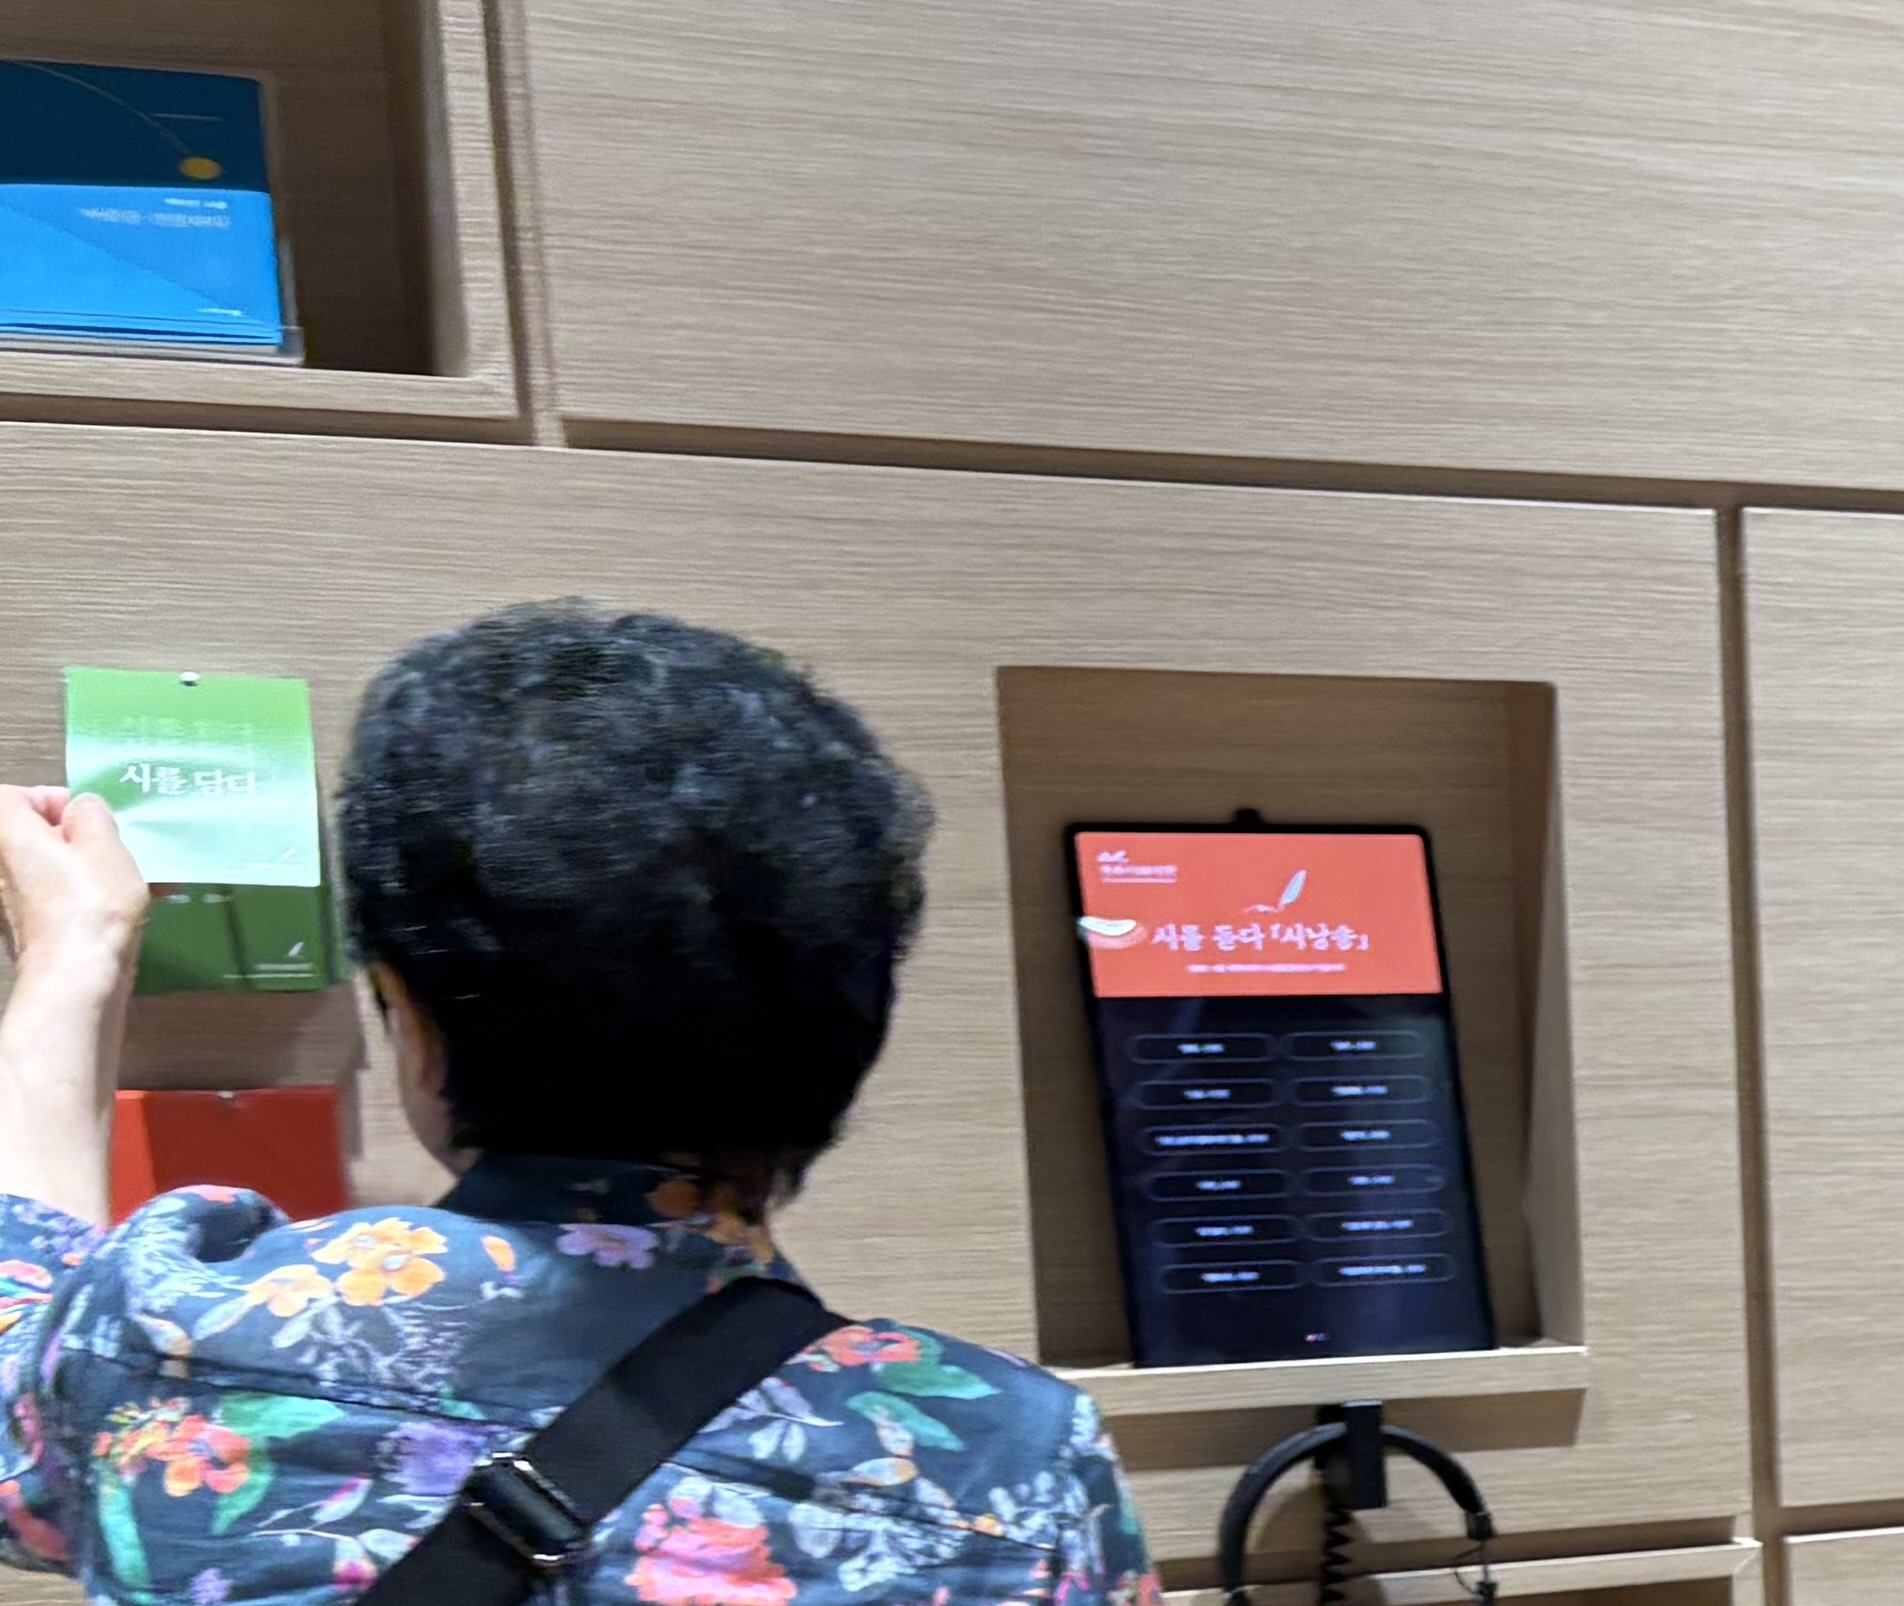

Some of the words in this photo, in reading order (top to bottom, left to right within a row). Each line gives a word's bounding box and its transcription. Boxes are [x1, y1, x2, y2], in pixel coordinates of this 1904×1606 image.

[119, 763, 187, 796] 시를
[193, 769, 260, 796] 담다
[1152, 923, 1204, 951] 시를
